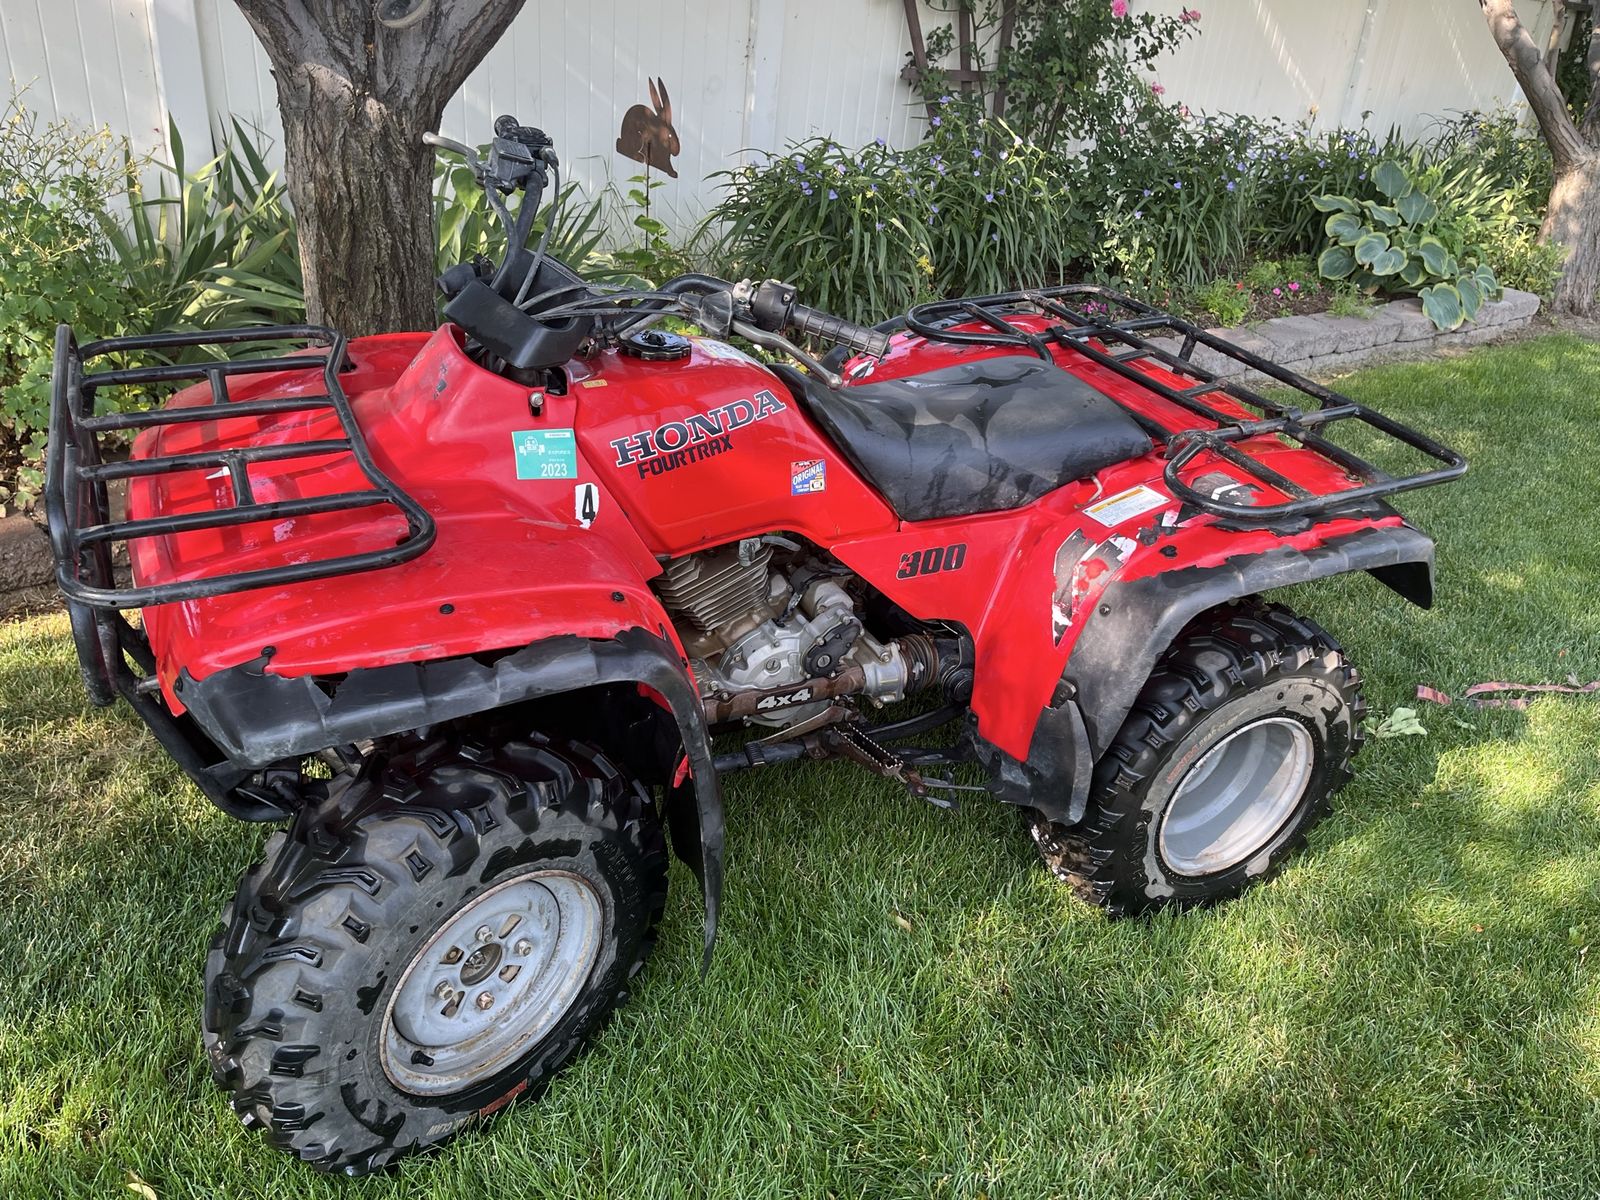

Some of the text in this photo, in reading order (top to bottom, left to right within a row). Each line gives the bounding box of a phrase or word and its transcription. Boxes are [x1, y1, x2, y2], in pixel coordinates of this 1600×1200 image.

[611, 390, 785, 467] HONDA
[541, 463, 568, 477] 2023
[637, 435, 733, 479] FOURTRAX
[793, 462, 823, 485] ORIGINAL
[582, 485, 596, 524] 4
[896, 543, 967, 580] 300
[757, 688, 811, 709] 4x4
